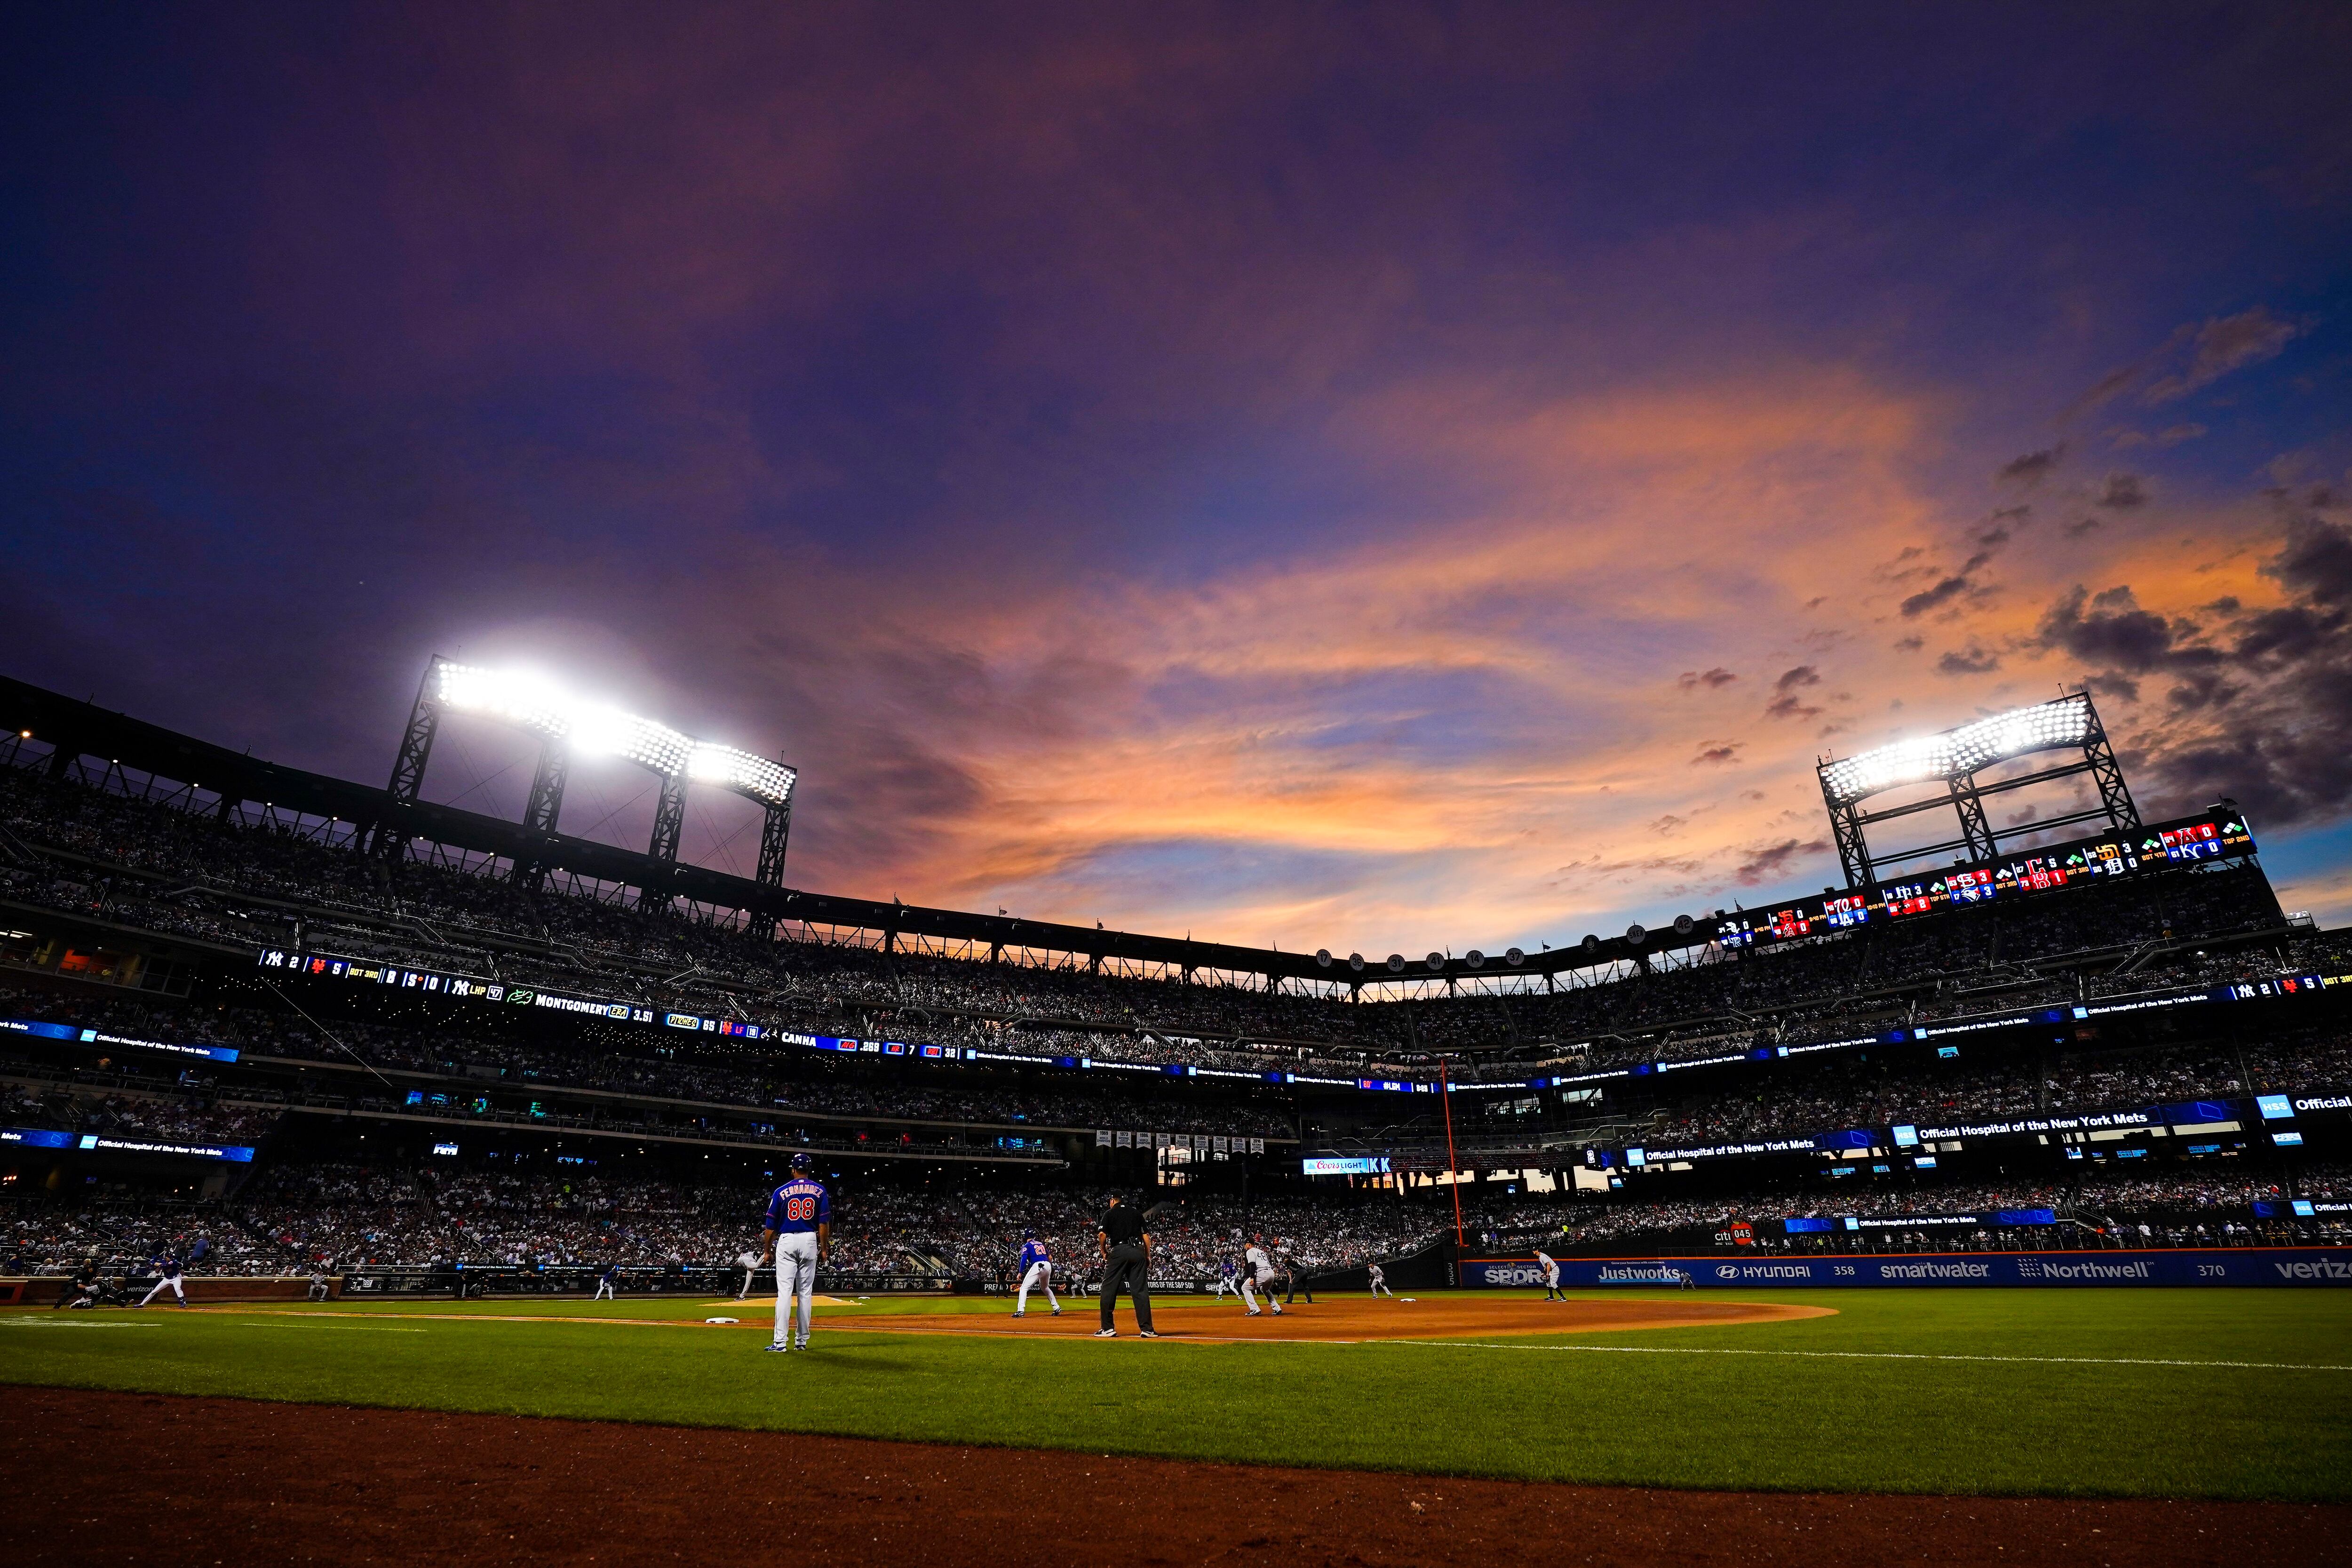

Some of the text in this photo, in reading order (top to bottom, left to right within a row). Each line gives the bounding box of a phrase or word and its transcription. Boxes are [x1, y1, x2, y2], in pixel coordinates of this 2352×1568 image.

[2201, 827, 2212, 837] 0
[2122, 843, 2131, 853] 3
[2179, 844, 2202, 859] KC
[2208, 842, 2218, 852] 0
[2048, 858, 2057, 868] 5
[2128, 857, 2137, 868] 0
[1979, 872, 1987, 882] 3
[2055, 872, 2061, 882] 1
[1915, 885, 1922, 895] 3
[1984, 886, 1992, 896] 3
[1854, 898, 1861, 907] 0
[1918, 899, 1926, 908] 2
[1796, 910, 1803, 919] 0
[1838, 913, 1854, 926] LA
[1858, 911, 1865, 920] 0
[1743, 921, 1749, 930] 0
[1800, 923, 1807, 931] 0
[1746, 933, 1752, 942] 0
[289, 956, 299, 968] 2
[332, 963, 342, 975] 5
[349, 968, 379, 979] BOT 3RD
[386, 970, 397, 984] B
[407, 974, 418, 987] S
[2323, 977, 2338, 985] BOT
[2260, 983, 2271, 995] 2
[2304, 978, 2315, 989] 5
[469, 985, 486, 995] LHP
[490, 989, 500, 997] 47
[535, 994, 610, 1016] MONTGOMERY
[611, 1007, 627, 1017] ERA
[633, 1010, 653, 1023] 3.51
[670, 1016, 715, 1031] PITCHES 65
[120, 1038, 148, 1046] Hospital
[781, 1032, 816, 1047] CANHA
[860, 1042, 880, 1052] .269
[909, 1045, 915, 1055] 7
[945, 1048, 956, 1058] 32
[2263, 1096, 2352, 1111] HSS Official
[1897, 1113, 2148, 1140] HSS Official Hospital of the New York Mets
[1646, 1150, 1676, 1160] Official
[1716, 1146, 1725, 1155] of
[1726, 1146, 1743, 1154] the
[1743, 1144, 1764, 1153] New
[1765, 1141, 1789, 1151] York
[1789, 1139, 1814, 1149] Mets
[1317, 1161, 1339, 1170] Coors
[779, 1184, 824, 1201] FERNANDEZ
[788, 1198, 815, 1220] 88
[1715, 1232, 1731, 1241] citi
[1734, 1229, 1750, 1238] 045
[1034, 1245, 1046, 1255] 20
[1598, 1266, 1681, 1280] Justworks
[1743, 1266, 1811, 1278] HYUNDAI
[1834, 1266, 1855, 1275] 358
[1881, 1261, 1988, 1278] smartwater
[2042, 1262, 2149, 1278] Northwell
[2197, 1265, 2225, 1276] 370
[1485, 1269, 1544, 1284] SPDR
